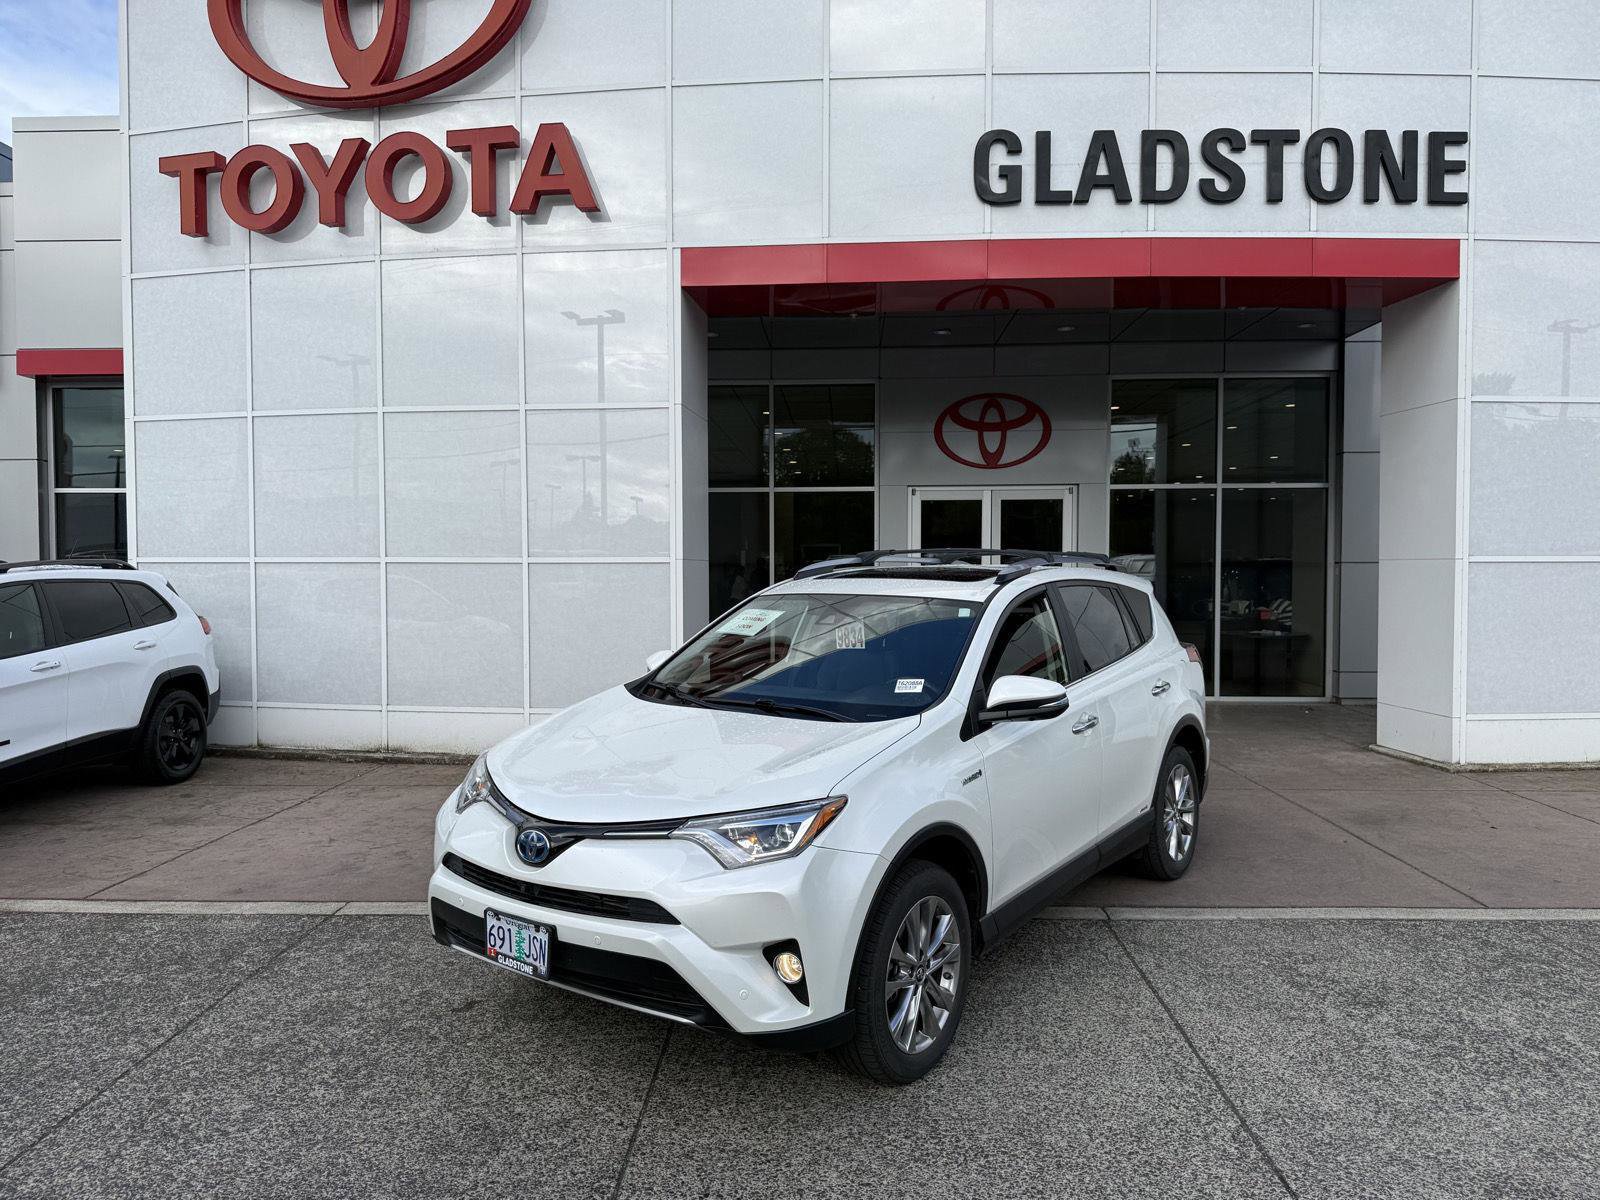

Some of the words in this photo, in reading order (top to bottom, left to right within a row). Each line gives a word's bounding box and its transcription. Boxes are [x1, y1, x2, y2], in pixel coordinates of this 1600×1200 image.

[159, 122, 601, 238] TOYOTA
[973, 127, 1469, 205] GLADSTONE
[837, 625, 864, 648] 9834
[488, 923, 512, 953] 691
[524, 933, 547, 966] JSN
[497, 954, 534, 975] GLADSTONE
